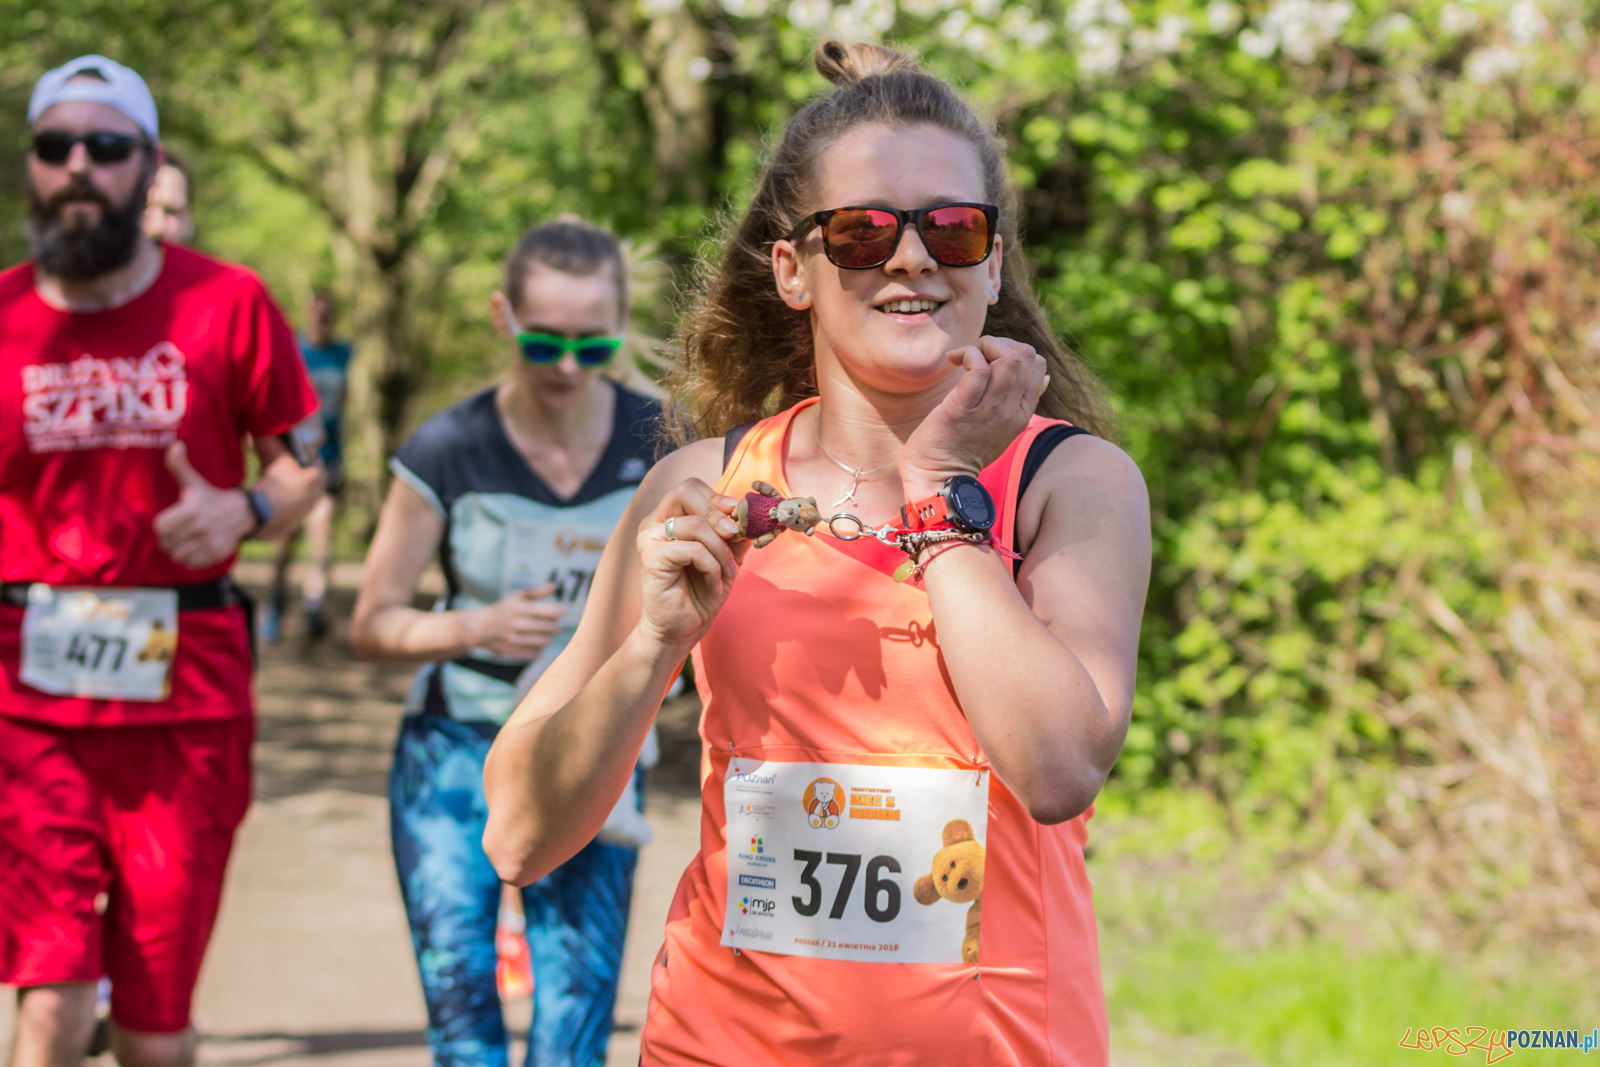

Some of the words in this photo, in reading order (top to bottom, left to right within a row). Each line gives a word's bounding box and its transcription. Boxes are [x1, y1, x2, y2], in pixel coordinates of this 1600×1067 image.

[23, 379, 187, 434] SZPIKU
[66, 633, 127, 671] 477
[850, 794, 882, 807] BIEG
[849, 807, 900, 821] MISIEM
[755, 855, 776, 863] CROSS
[741, 876, 774, 888] DECATHLON
[791, 848, 902, 923] 376
[752, 898, 775, 912] mjp
[827, 940, 836, 948] 21
[878, 943, 899, 951] 2018
